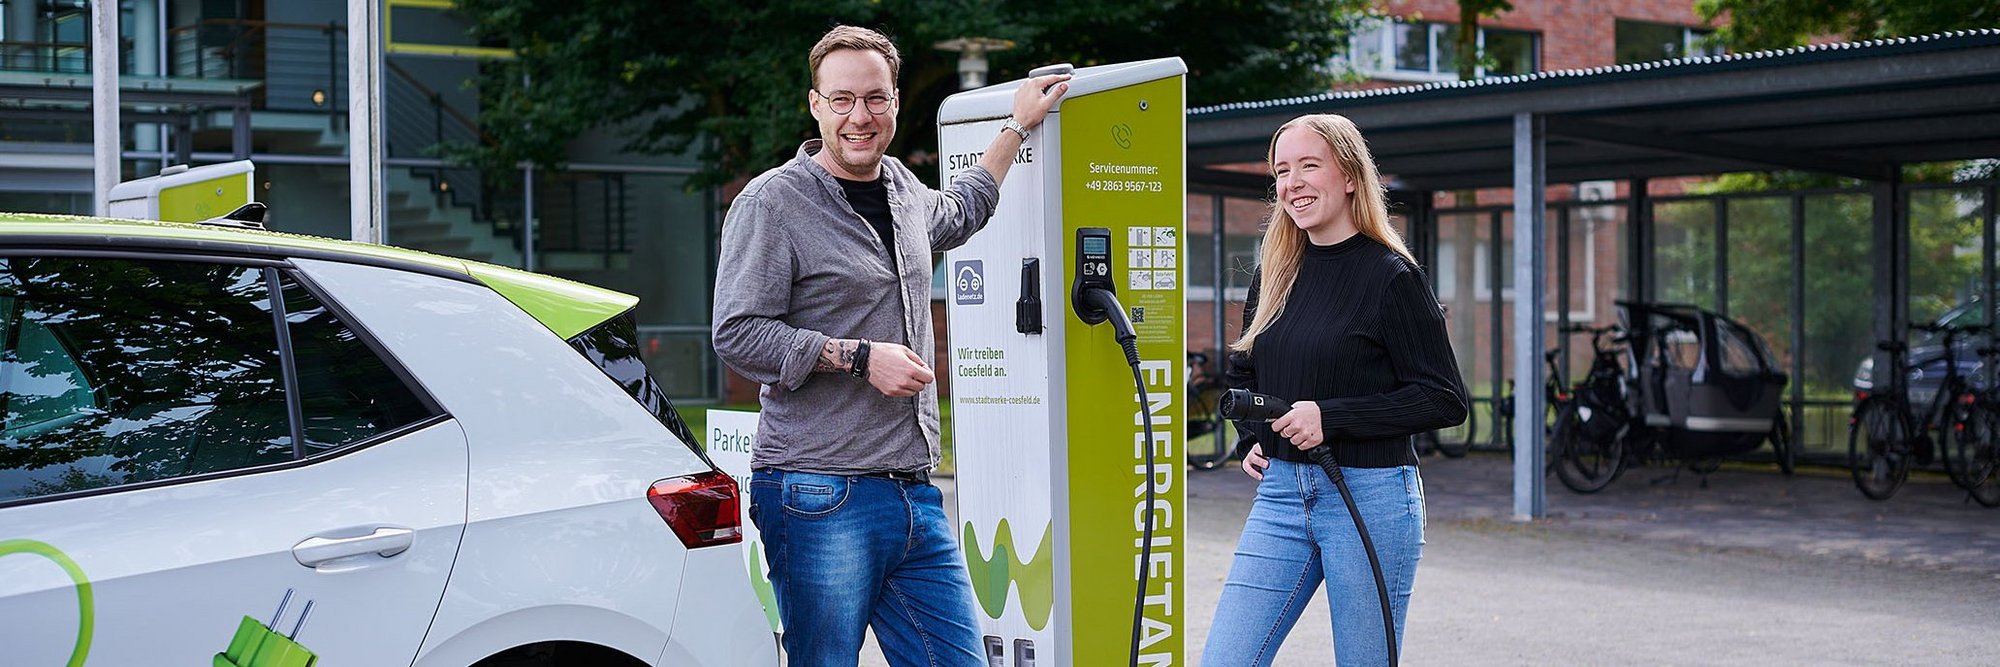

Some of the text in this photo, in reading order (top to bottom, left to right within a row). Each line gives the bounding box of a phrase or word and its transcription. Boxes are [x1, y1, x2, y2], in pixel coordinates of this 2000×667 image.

[1089, 162, 1158, 175] Servicenummer:
[1085, 180, 1162, 192] +49 2863 9567-123
[958, 347, 1004, 360] Wir treiben
[958, 364, 1007, 377] Coesfeld an.
[960, 395, 1041, 405] www.stadtwerke-coesfeld.de
[714, 428, 753, 453] Parke
